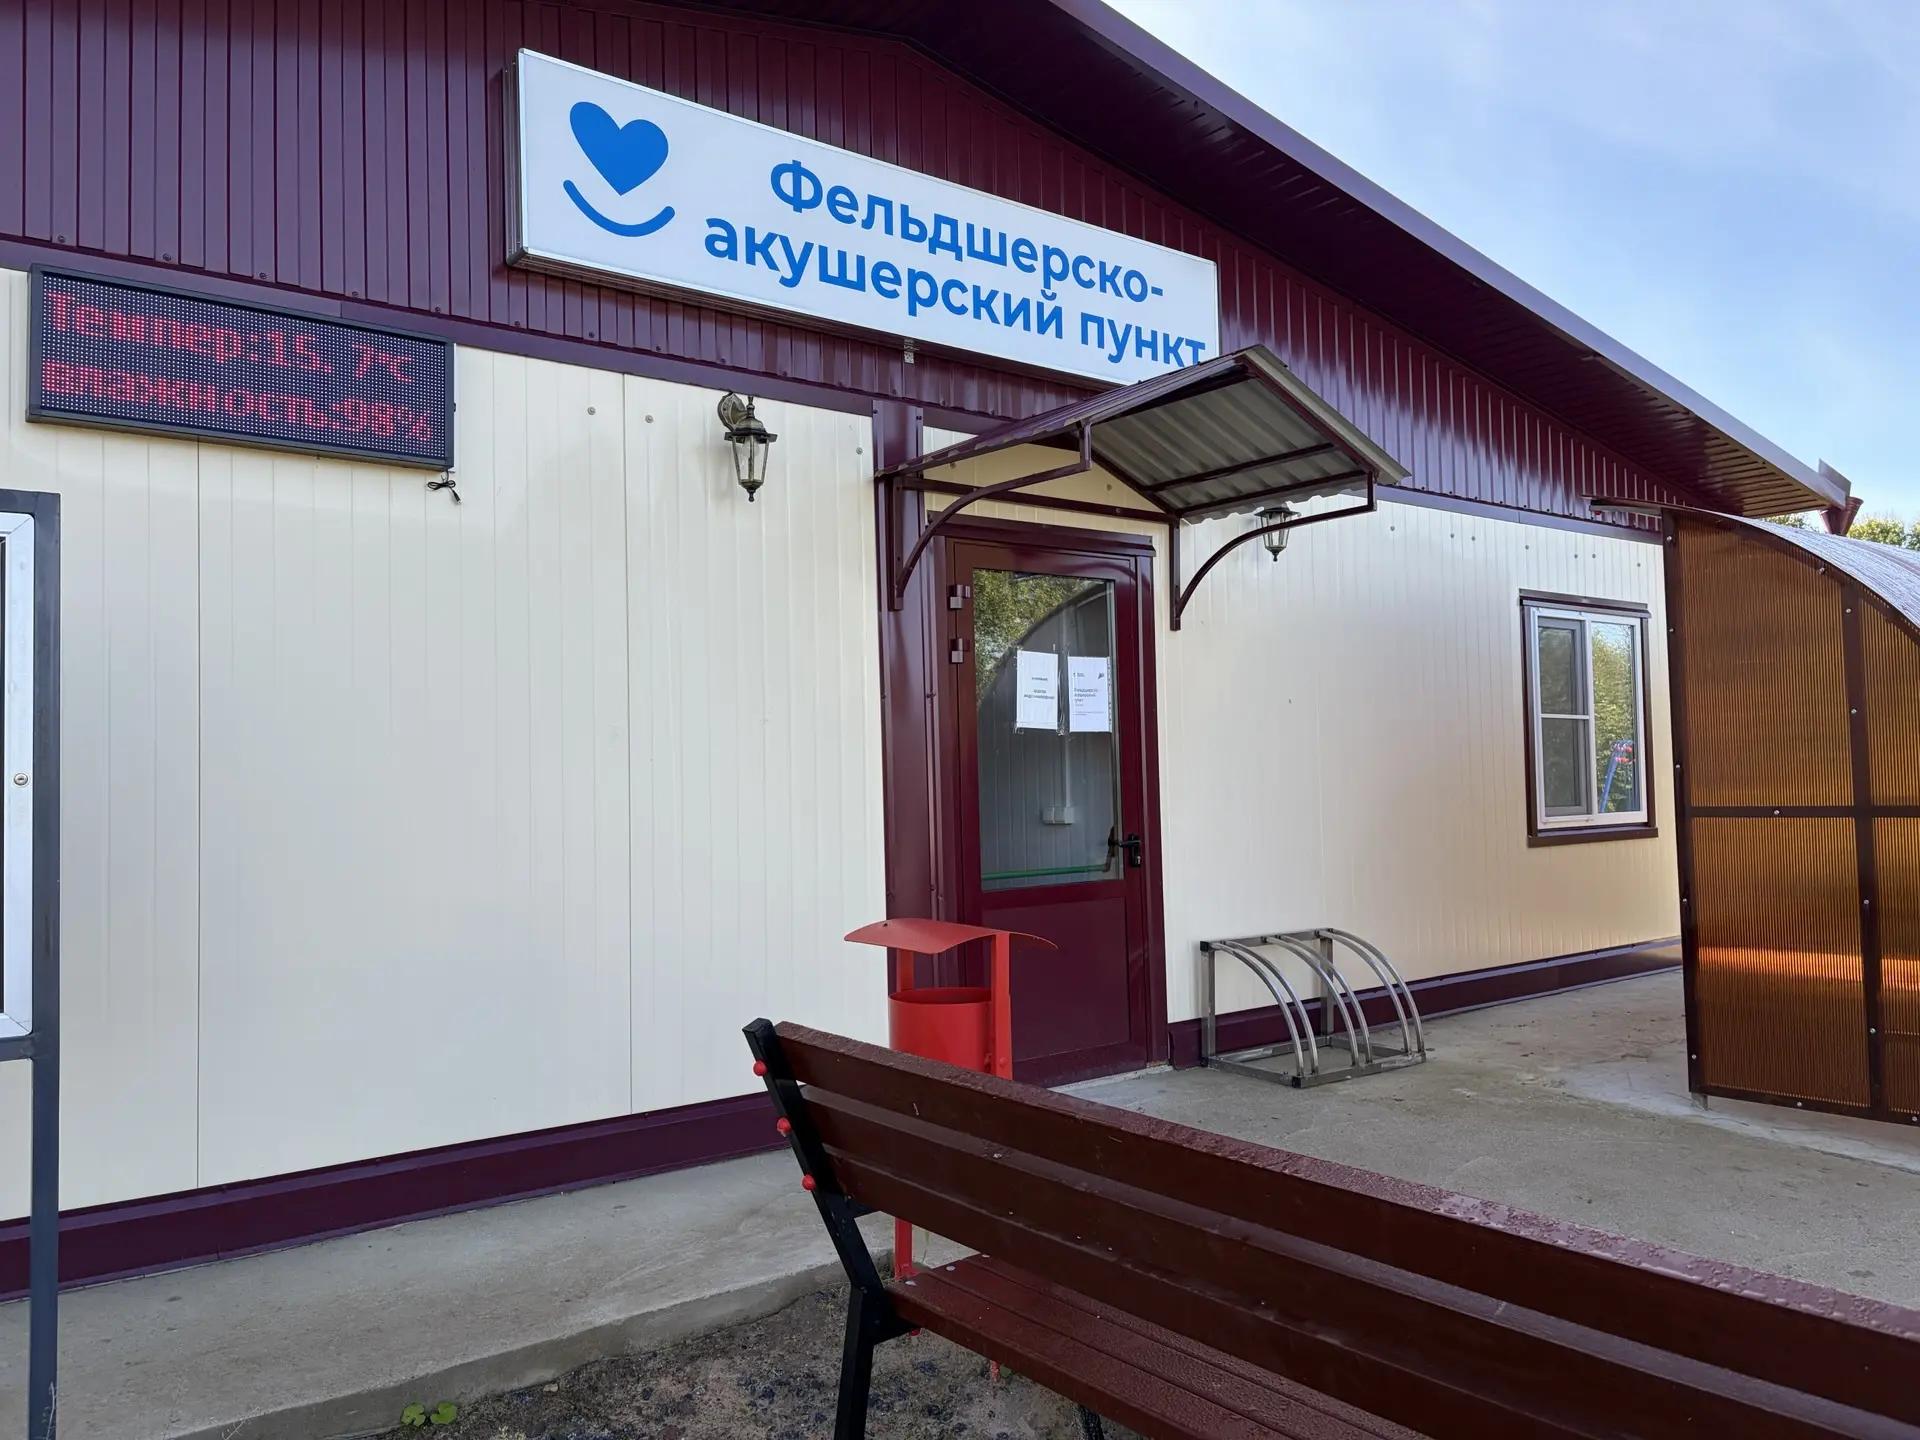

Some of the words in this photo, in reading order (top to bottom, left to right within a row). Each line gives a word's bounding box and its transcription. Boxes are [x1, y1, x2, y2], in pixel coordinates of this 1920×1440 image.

[703, 216, 1064, 339] акушерский
[1080, 311, 1206, 366] пункт
[769, 159, 1164, 303] Фельдшерско-
